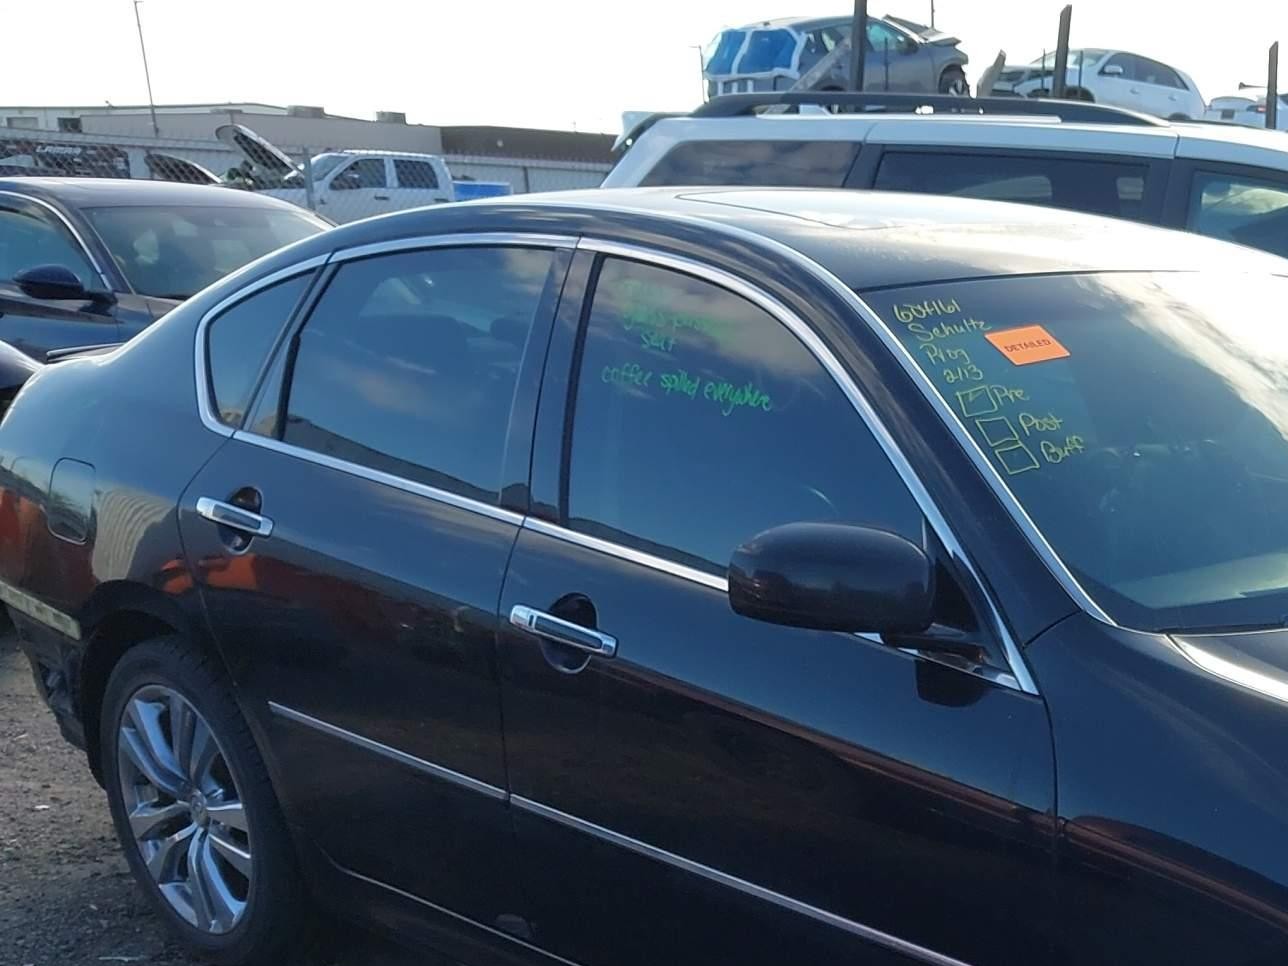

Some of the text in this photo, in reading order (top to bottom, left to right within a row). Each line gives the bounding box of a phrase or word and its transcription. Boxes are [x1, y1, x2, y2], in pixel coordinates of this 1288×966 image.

[1004, 338, 1053, 353] DETAILED
[943, 364, 984, 384] 2/13
[703, 380, 772, 417] everywhere
[989, 384, 1030, 406] Pre
[1018, 409, 1064, 437] Post
